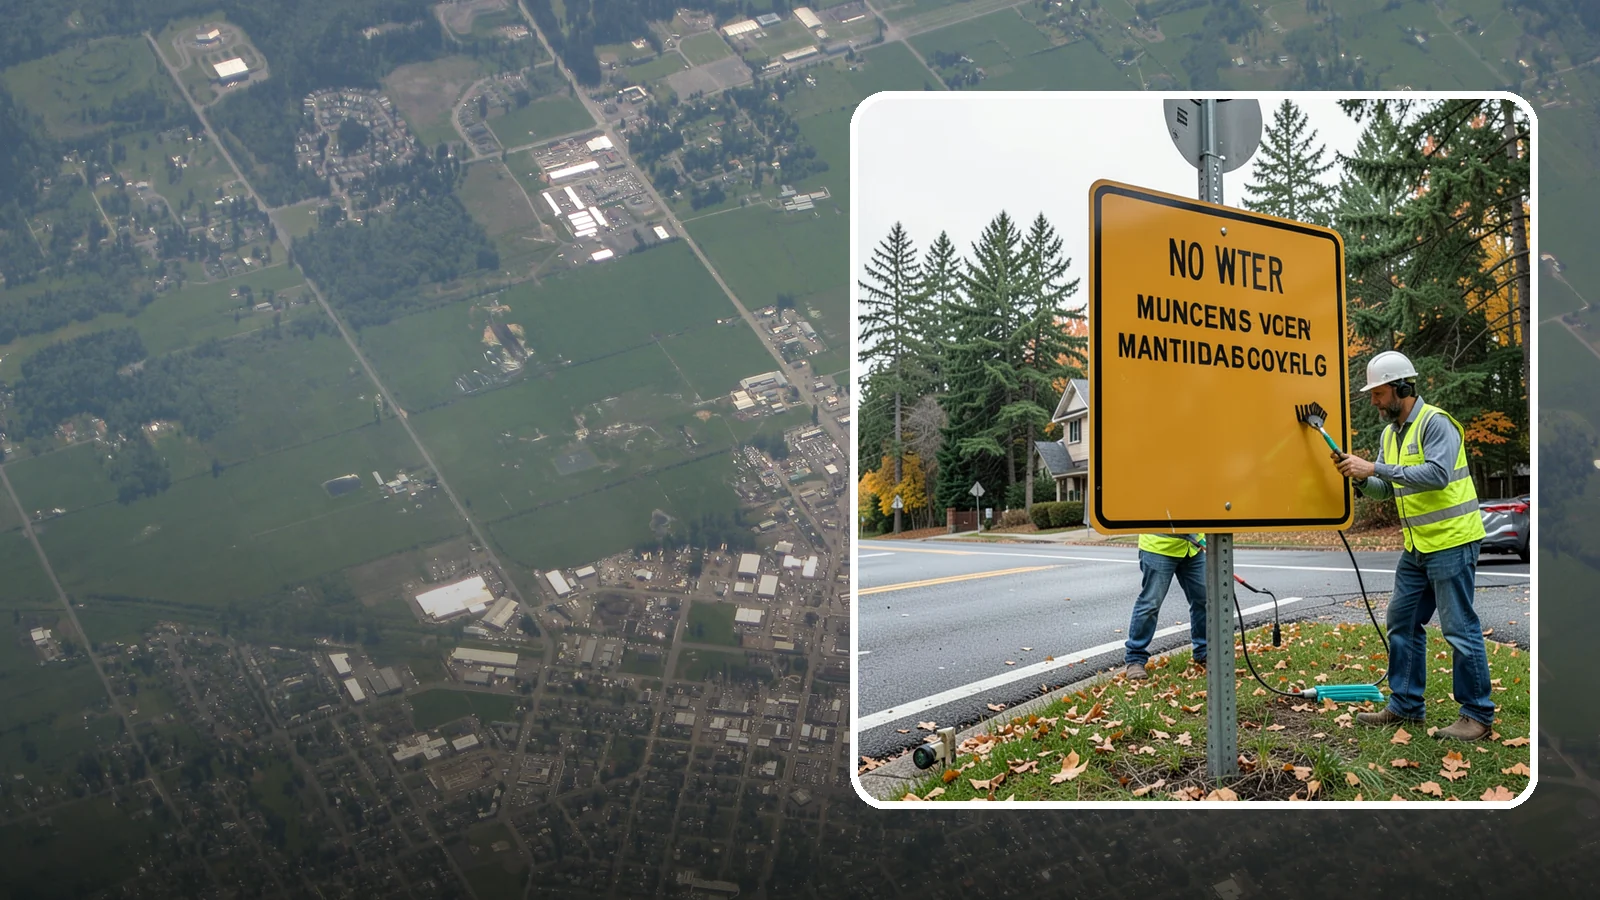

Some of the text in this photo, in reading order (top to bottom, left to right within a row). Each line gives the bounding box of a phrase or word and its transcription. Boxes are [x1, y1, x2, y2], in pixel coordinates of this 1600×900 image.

[1169, 237, 1284, 294] NO WTER
[1137, 293, 1252, 333] MUNCENS
